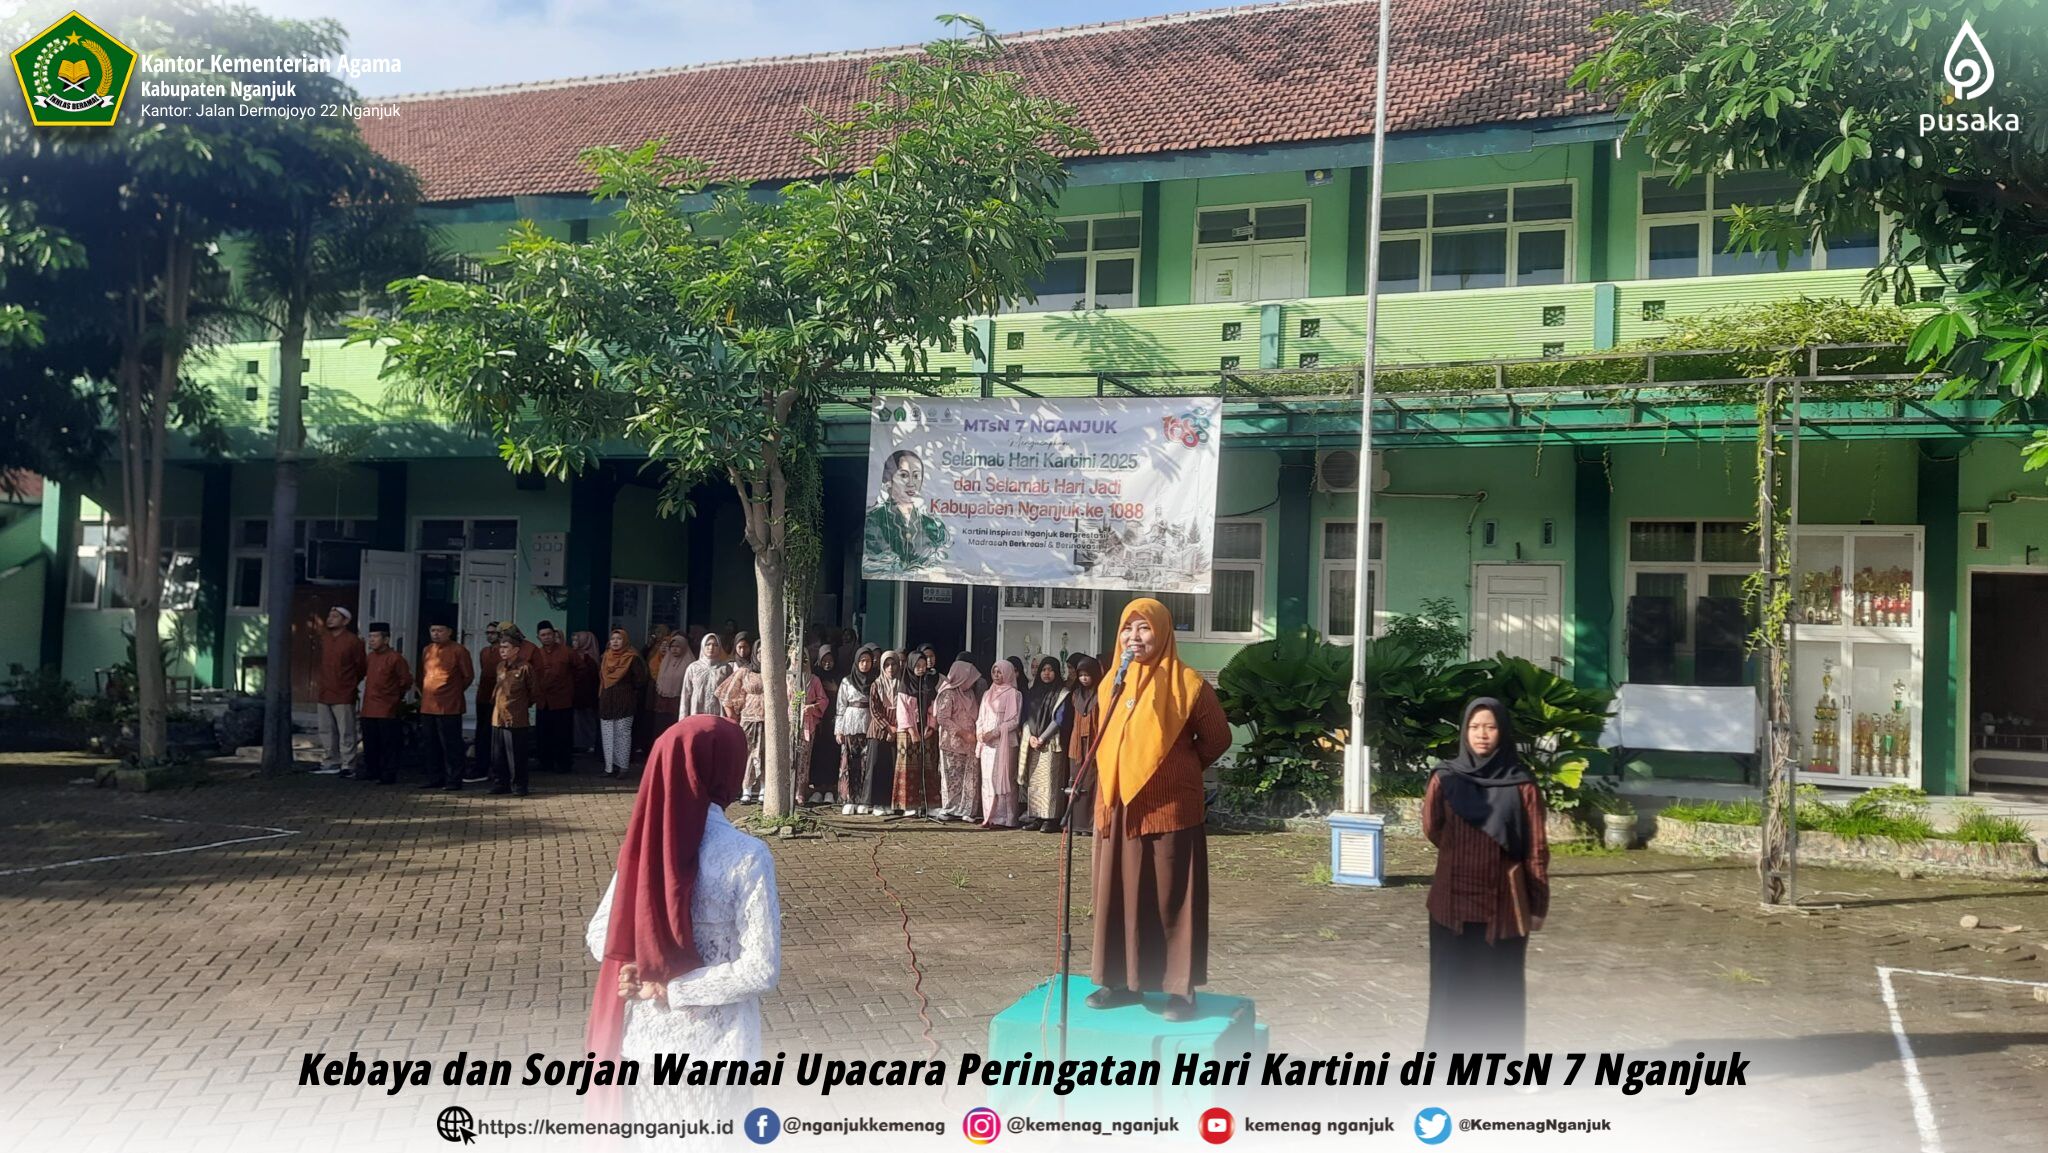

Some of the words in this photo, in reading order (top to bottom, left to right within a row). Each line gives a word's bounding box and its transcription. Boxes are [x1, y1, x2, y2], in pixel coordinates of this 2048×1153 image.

[963, 418, 1010, 433] MTsN
[1015, 419, 1026, 433] 7
[1030, 419, 1118, 434] NGANJUK
[941, 451, 1005, 468] Selamat
[1008, 452, 1040, 468] Hari
[1043, 452, 1096, 469] Kartini
[1100, 453, 1139, 470] 2025
[953, 476, 981, 492] dan
[985, 477, 1050, 494] Selamat
[1053, 478, 1085, 495] Hari
[1088, 479, 1121, 495] Jadi
[930, 499, 1014, 519] Kabupaten
[1109, 502, 1144, 519] 1088
[1024, 530, 1058, 540] Nganjuk
